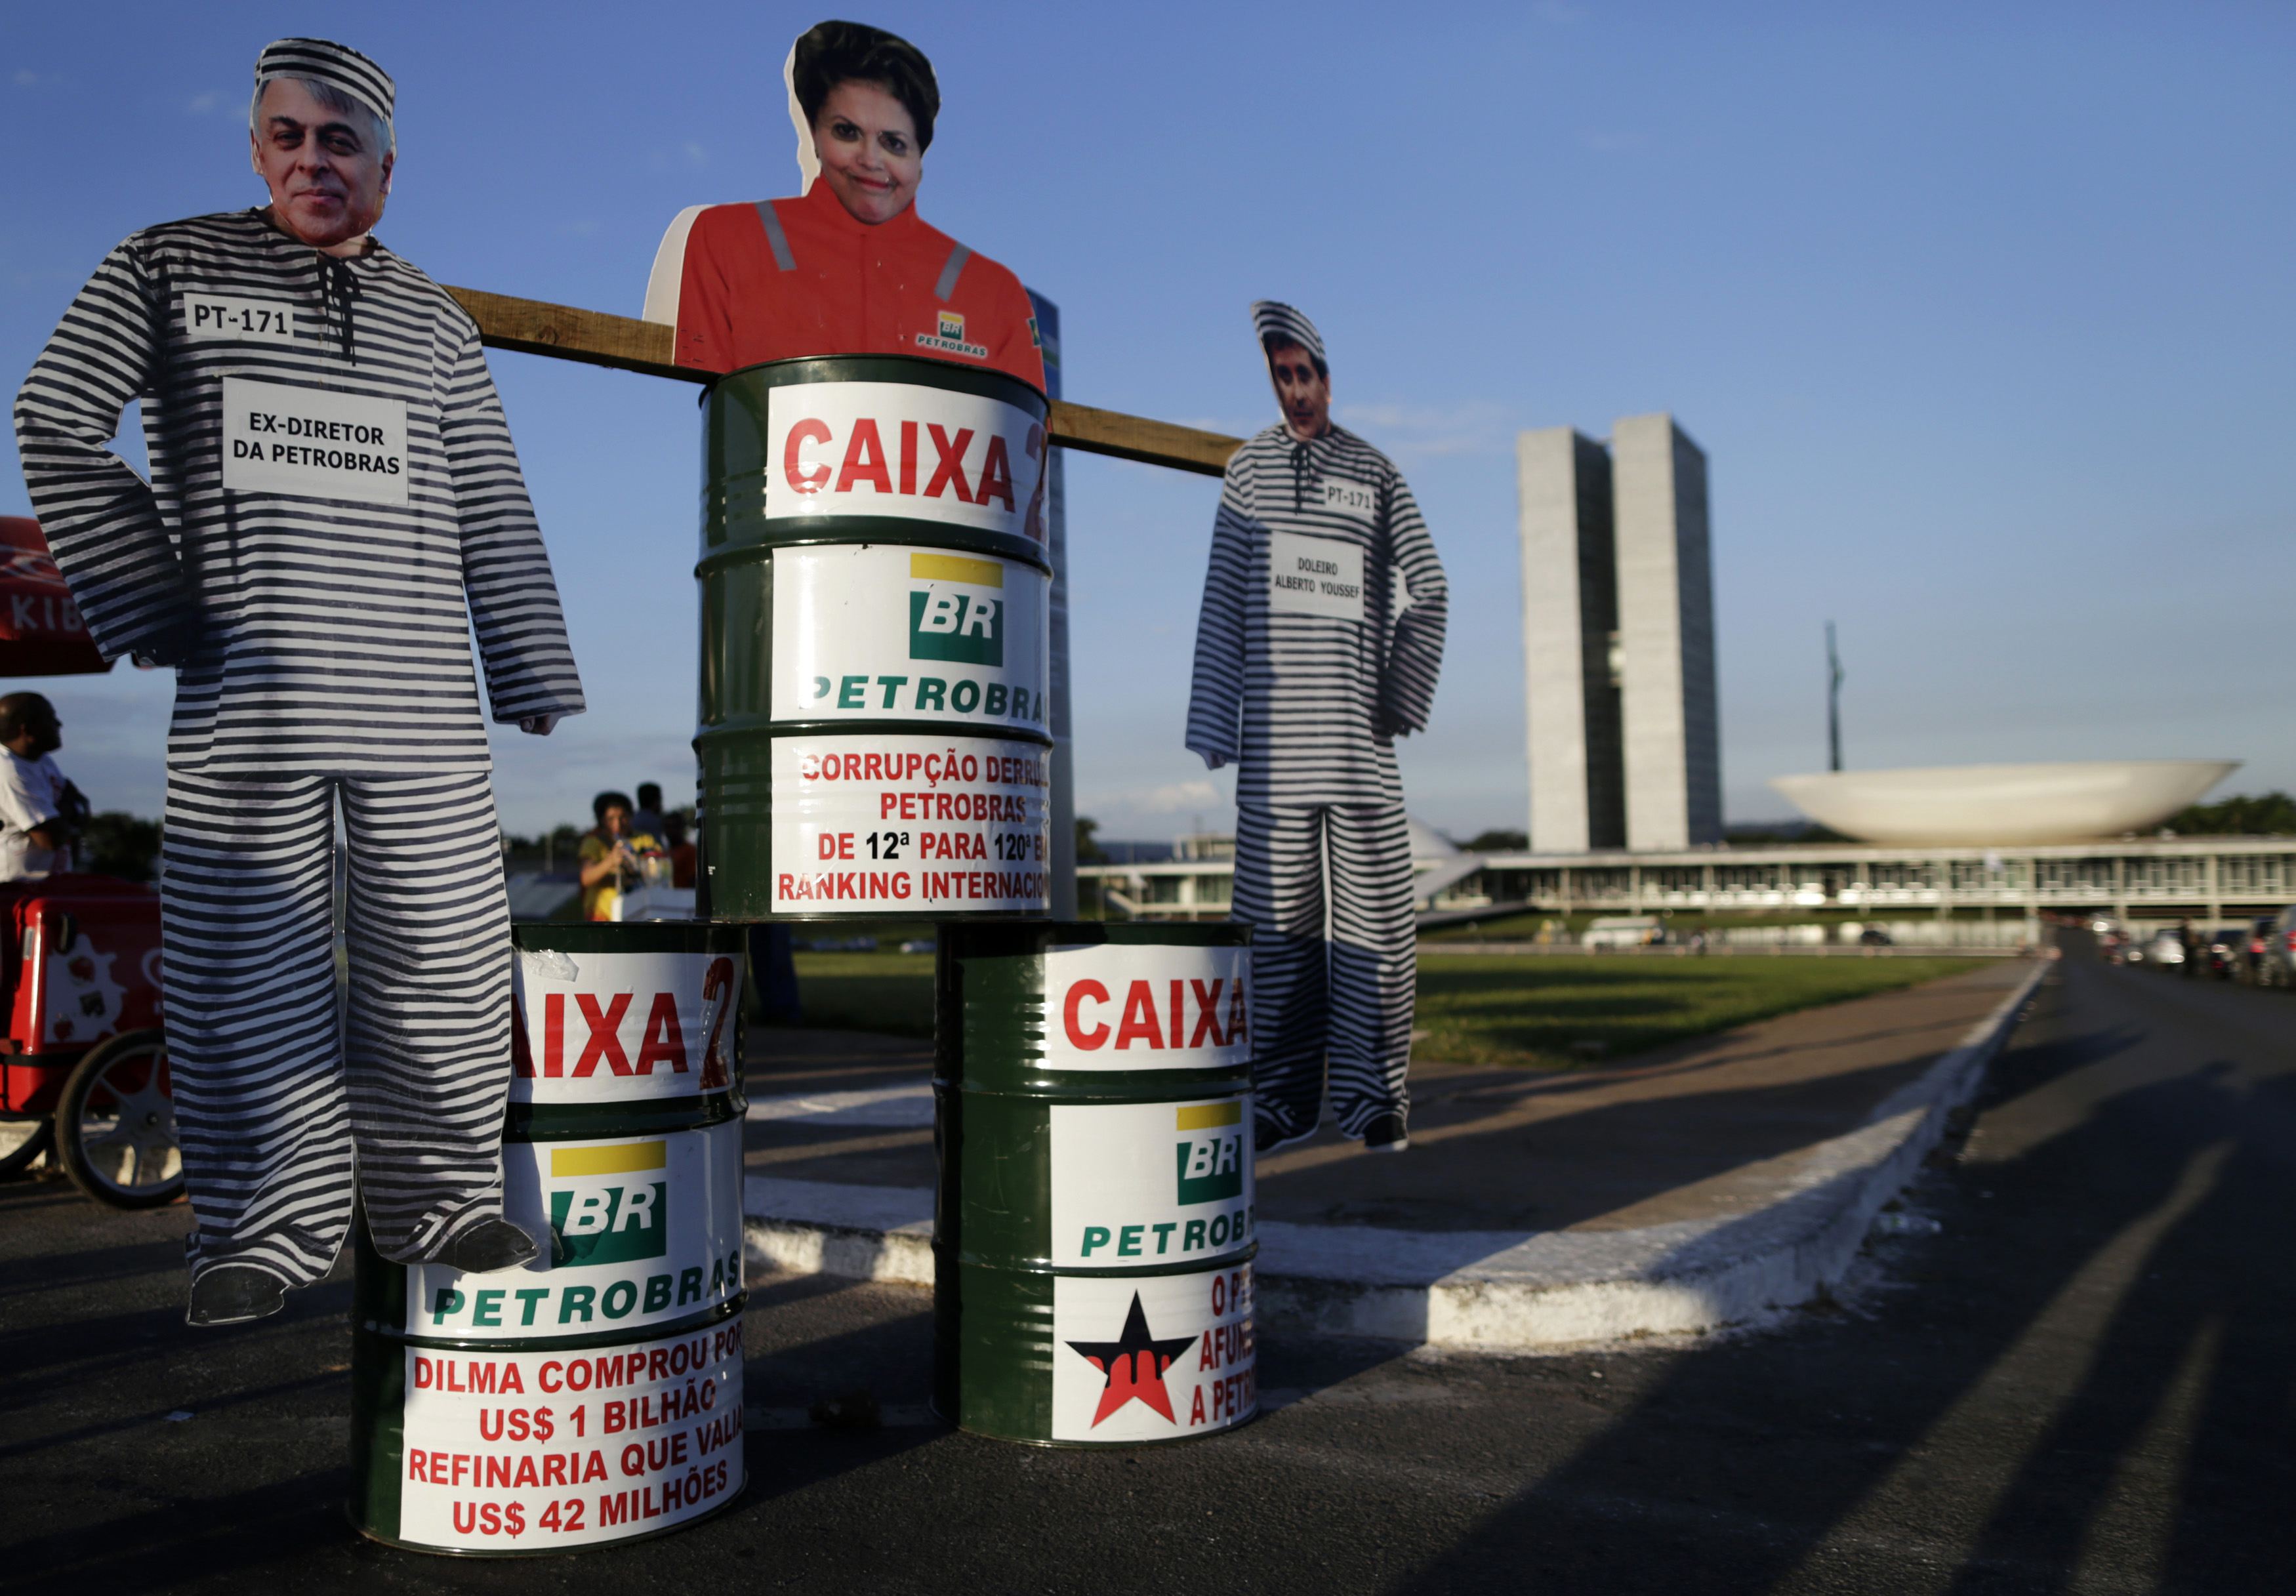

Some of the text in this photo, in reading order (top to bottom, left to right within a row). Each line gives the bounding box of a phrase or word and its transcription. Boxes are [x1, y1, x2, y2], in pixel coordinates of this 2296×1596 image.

[194, 304, 288, 335] PT-171
[918, 335, 987, 356] PETROBRAS
[250, 412, 384, 445] EX-DIRETOR
[234, 439, 400, 475] DA PETROBRAS
[784, 418, 1015, 514] CAIXA
[1328, 485, 1371, 509] PT-171
[1275, 574, 1360, 599] ALBERTO YOUSSEF
[1298, 557, 1338, 576] DOLEIRO
[918, 591, 997, 639] BR
[799, 675, 1048, 724] PETROBRA
[802, 748, 1048, 788] CORRUPÇÃO DERRU
[881, 792, 1026, 823] PETROBRAS
[818, 832, 855, 861] DE
[920, 832, 987, 861] PARA
[779, 871, 1049, 900] RANKING INTERNACIO
[511, 956, 735, 1090] AIXA 2
[1063, 977, 1248, 1052] CAIXA
[1184, 1136, 1239, 1180] BR
[562, 1183, 657, 1236] BR
[432, 1250, 739, 1326] PETROBRAS
[1212, 1275, 1225, 1317] O
[414, 1320, 743, 1395] DILMA COMPROU POR
[480, 1377, 716, 1444] US$ 1 BILHÃO
[1190, 1385, 1206, 1426] A
[409, 1448, 609, 1488] REFINARIA
[621, 1432, 688, 1477] QUE
[453, 1460, 728, 1539] US$ 42 MILHÕES
